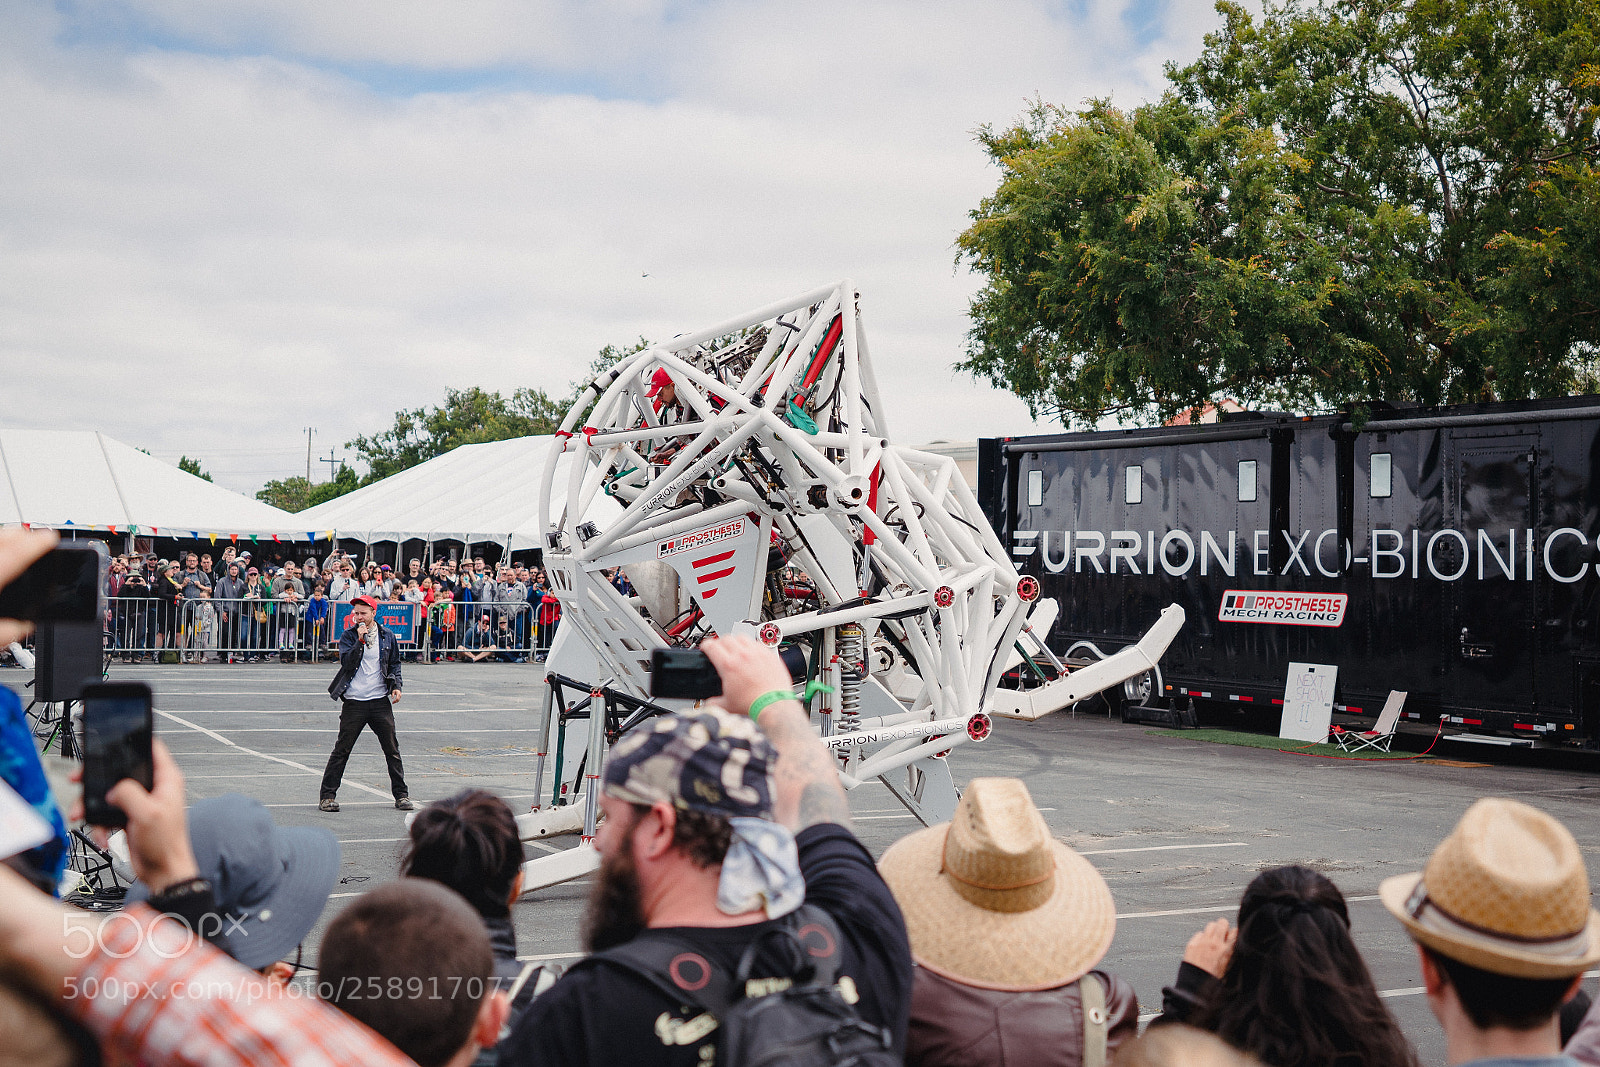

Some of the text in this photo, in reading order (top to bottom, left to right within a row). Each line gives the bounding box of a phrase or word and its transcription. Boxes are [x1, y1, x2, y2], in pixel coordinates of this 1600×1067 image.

[642, 483, 677, 514] FURRION
[682, 522, 742, 545] PROSTHESIS
[660, 530, 740, 556] MECH RACING
[1013, 527, 1600, 583] FURRION EXO-BIONIC
[1255, 596, 1341, 612] PROSTHESIS
[382, 616, 408, 625] TELL
[1223, 609, 1338, 621] MECH RACING
[1296, 673, 1326, 688] NEXT
[1296, 687, 1327, 702] SHOW
[881, 722, 964, 742] EXO-BIONICS
